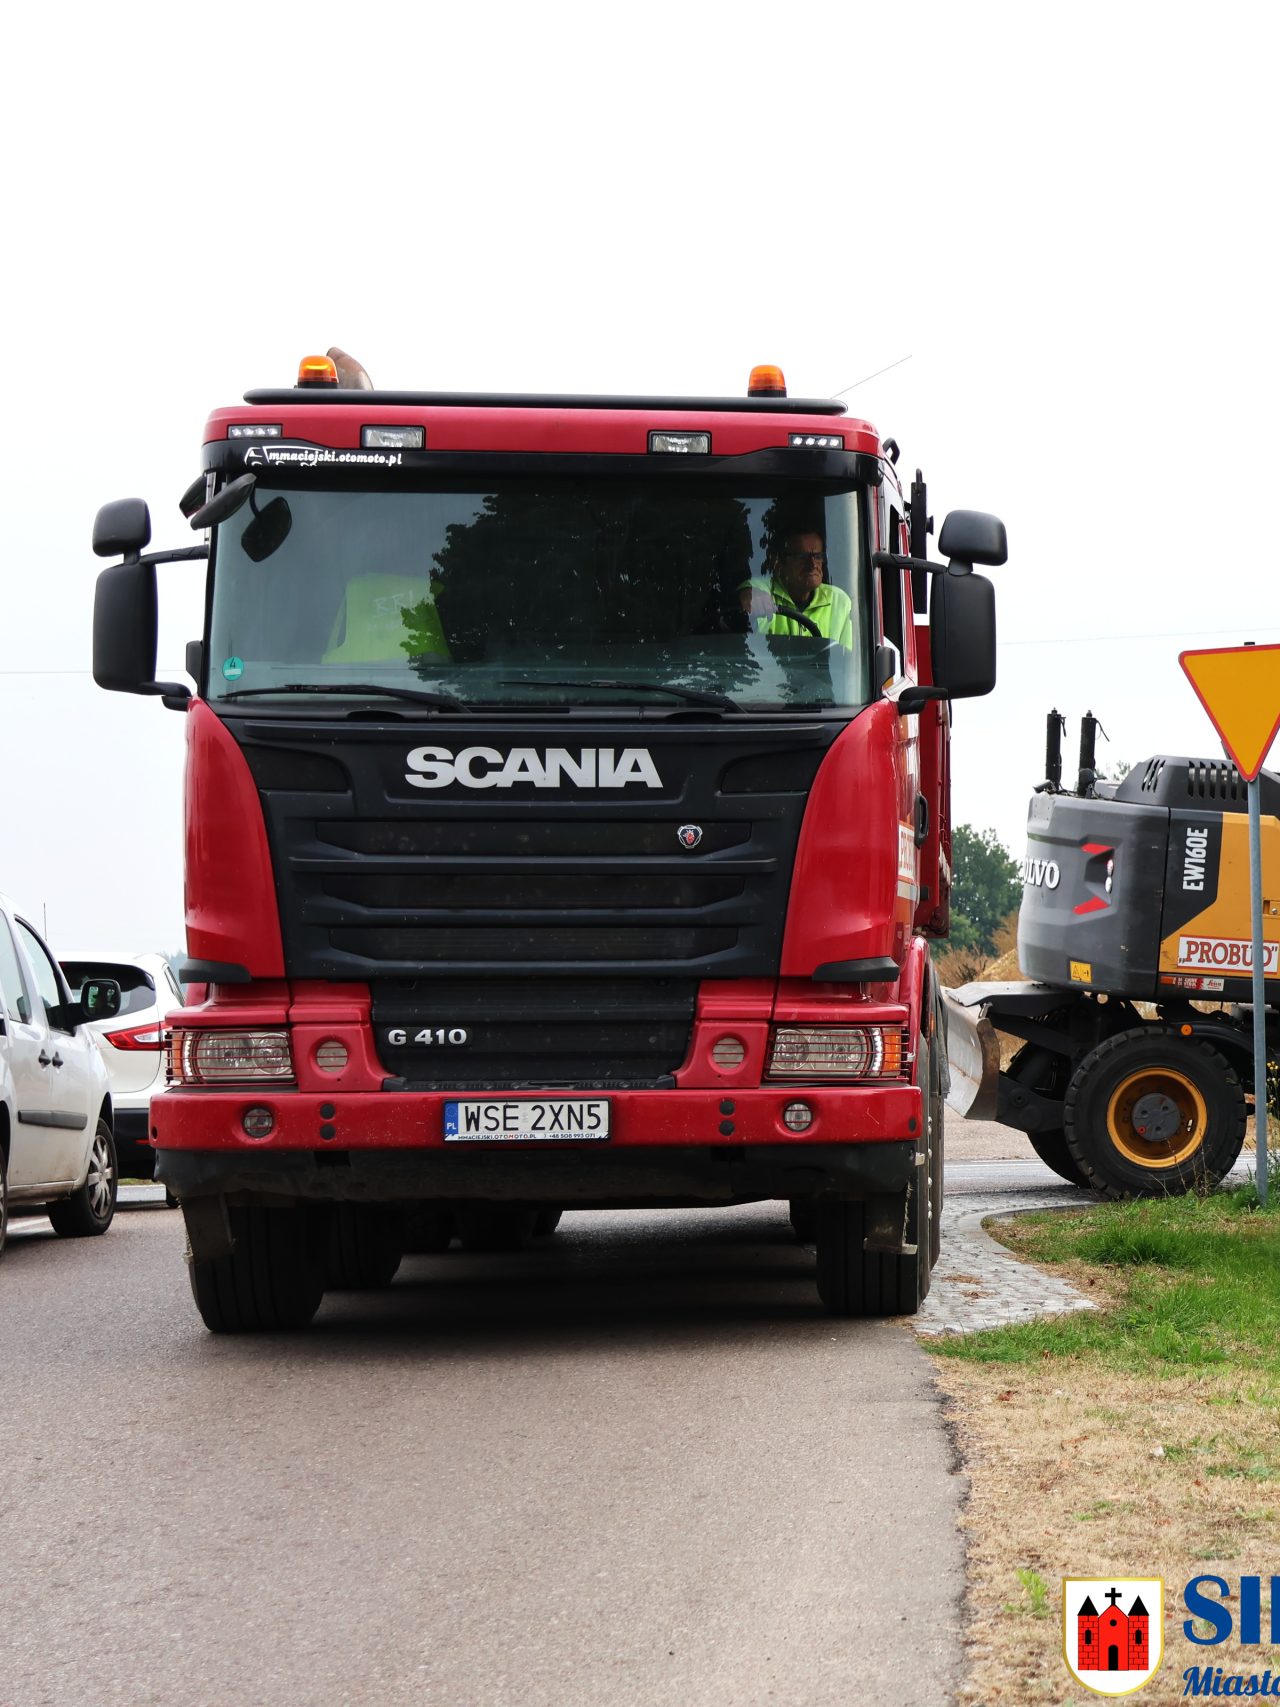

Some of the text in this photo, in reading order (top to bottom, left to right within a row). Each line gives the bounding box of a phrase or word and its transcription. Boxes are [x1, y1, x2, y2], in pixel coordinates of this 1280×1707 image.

[269, 450, 403, 467] mmaciejski.otomoto.pl
[230, 657, 236, 669] 4
[404, 746, 664, 789] SCANIA
[1182, 827, 1209, 892] EW160E
[1023, 857, 1060, 889] OLVO
[388, 1028, 468, 1045] G 410
[446, 1122, 457, 1130] PL
[465, 1104, 602, 1132] WSE 2XN5
